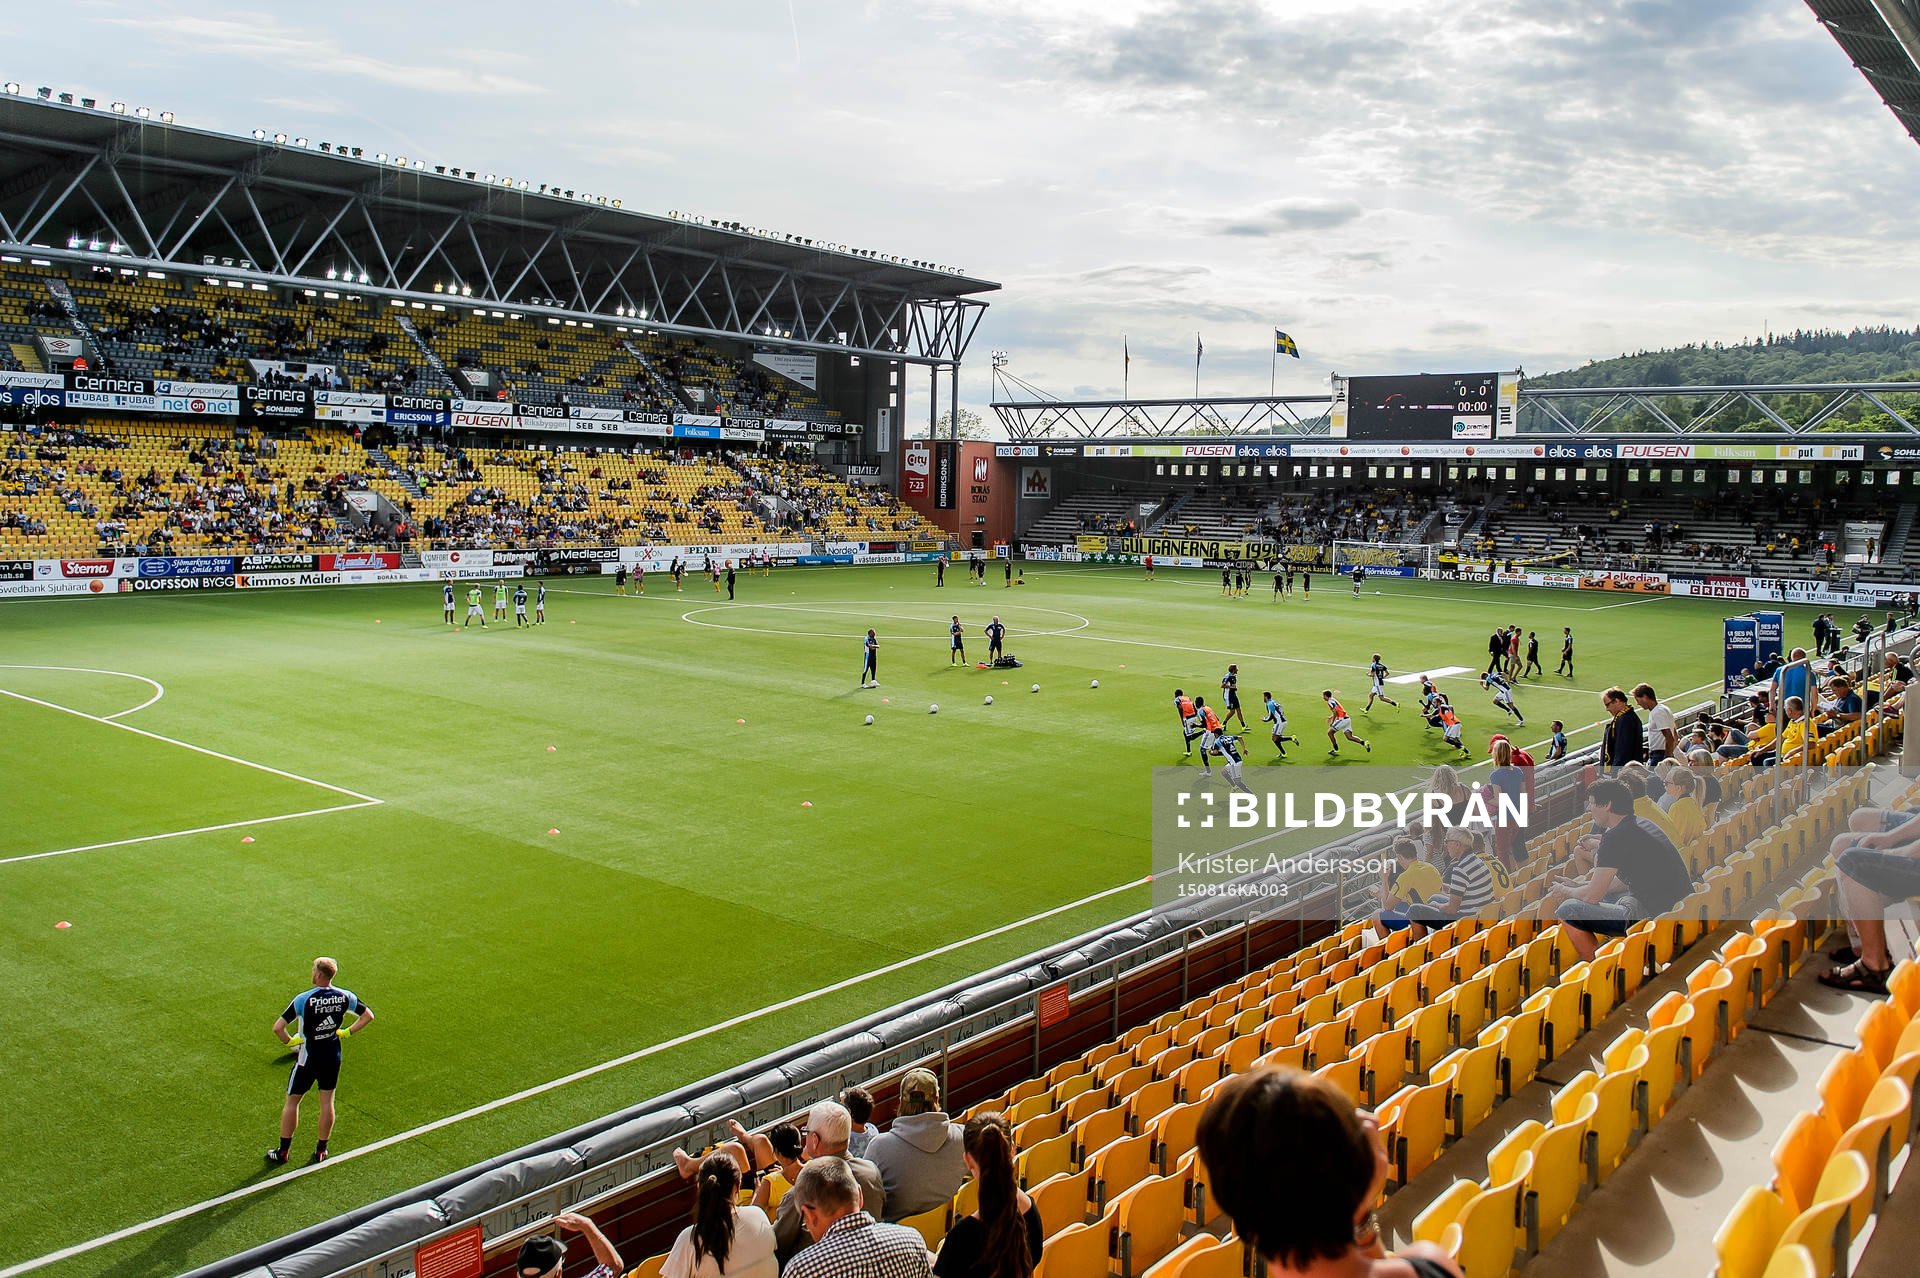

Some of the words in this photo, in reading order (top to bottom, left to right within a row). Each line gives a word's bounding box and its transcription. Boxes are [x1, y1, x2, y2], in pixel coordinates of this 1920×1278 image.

[75, 376, 144, 393] Cernera
[247, 387, 306, 402] Cernera
[1460, 386, 1467, 397] 0
[1480, 385, 1487, 396] 0
[23, 389, 60, 406] ellos
[82, 394, 109, 402] UBAB
[129, 396, 155, 404] UBAB
[393, 396, 443, 410] Cernera
[519, 404, 564, 417] Cernera
[1458, 401, 1487, 412] 00:00
[394, 412, 432, 421] ERICSSON
[455, 413, 510, 427] PULSEN
[628, 411, 668, 424] Cernera
[576, 422, 593, 430] SEB
[601, 423, 618, 431] SEB
[725, 418, 760, 429] Cernera
[810, 422, 842, 433] Cernera
[1185, 446, 1233, 456] PULSEN
[1239, 445, 1260, 457] ellos
[1266, 445, 1287, 457] ellos
[1549, 445, 1576, 458] ellos
[1584, 445, 1613, 458] ellos
[1621, 446, 1690, 457] PULSEN
[907, 454, 927, 466] City
[909, 481, 925, 490] 7-23
[940, 458, 948, 507] DIDRIKSONS
[688, 546, 718, 554] PEAB
[828, 547, 858, 555] Nordea
[1121, 537, 1220, 559] GULIGANERNA
[1246, 543, 1276, 559] 199
[560, 549, 618, 559] Mediacad
[635, 548, 662, 560] BOXON
[1036, 552, 1052, 560] TIPS
[242, 556, 281, 565] ASPA
[293, 555, 313, 564] AB
[12, 562, 32, 570] AB
[1313, 564, 1338, 573] karaktr
[459, 569, 523, 578] ElkraftsByggarna
[1441, 570, 1490, 582] XL-BYGG
[134, 578, 199, 590] OLOFSSON
[202, 577, 234, 587] BYGG
[241, 575, 296, 587] Kimmos
[48, 582, 87, 593] Sjuhärad
[1692, 586, 1748, 597] CRAMO
[1854, 595, 1875, 603] UBAB
[1496, 865, 1510, 889] 8
[309, 994, 346, 1007] Prioritet
[314, 1004, 342, 1014] Finans
